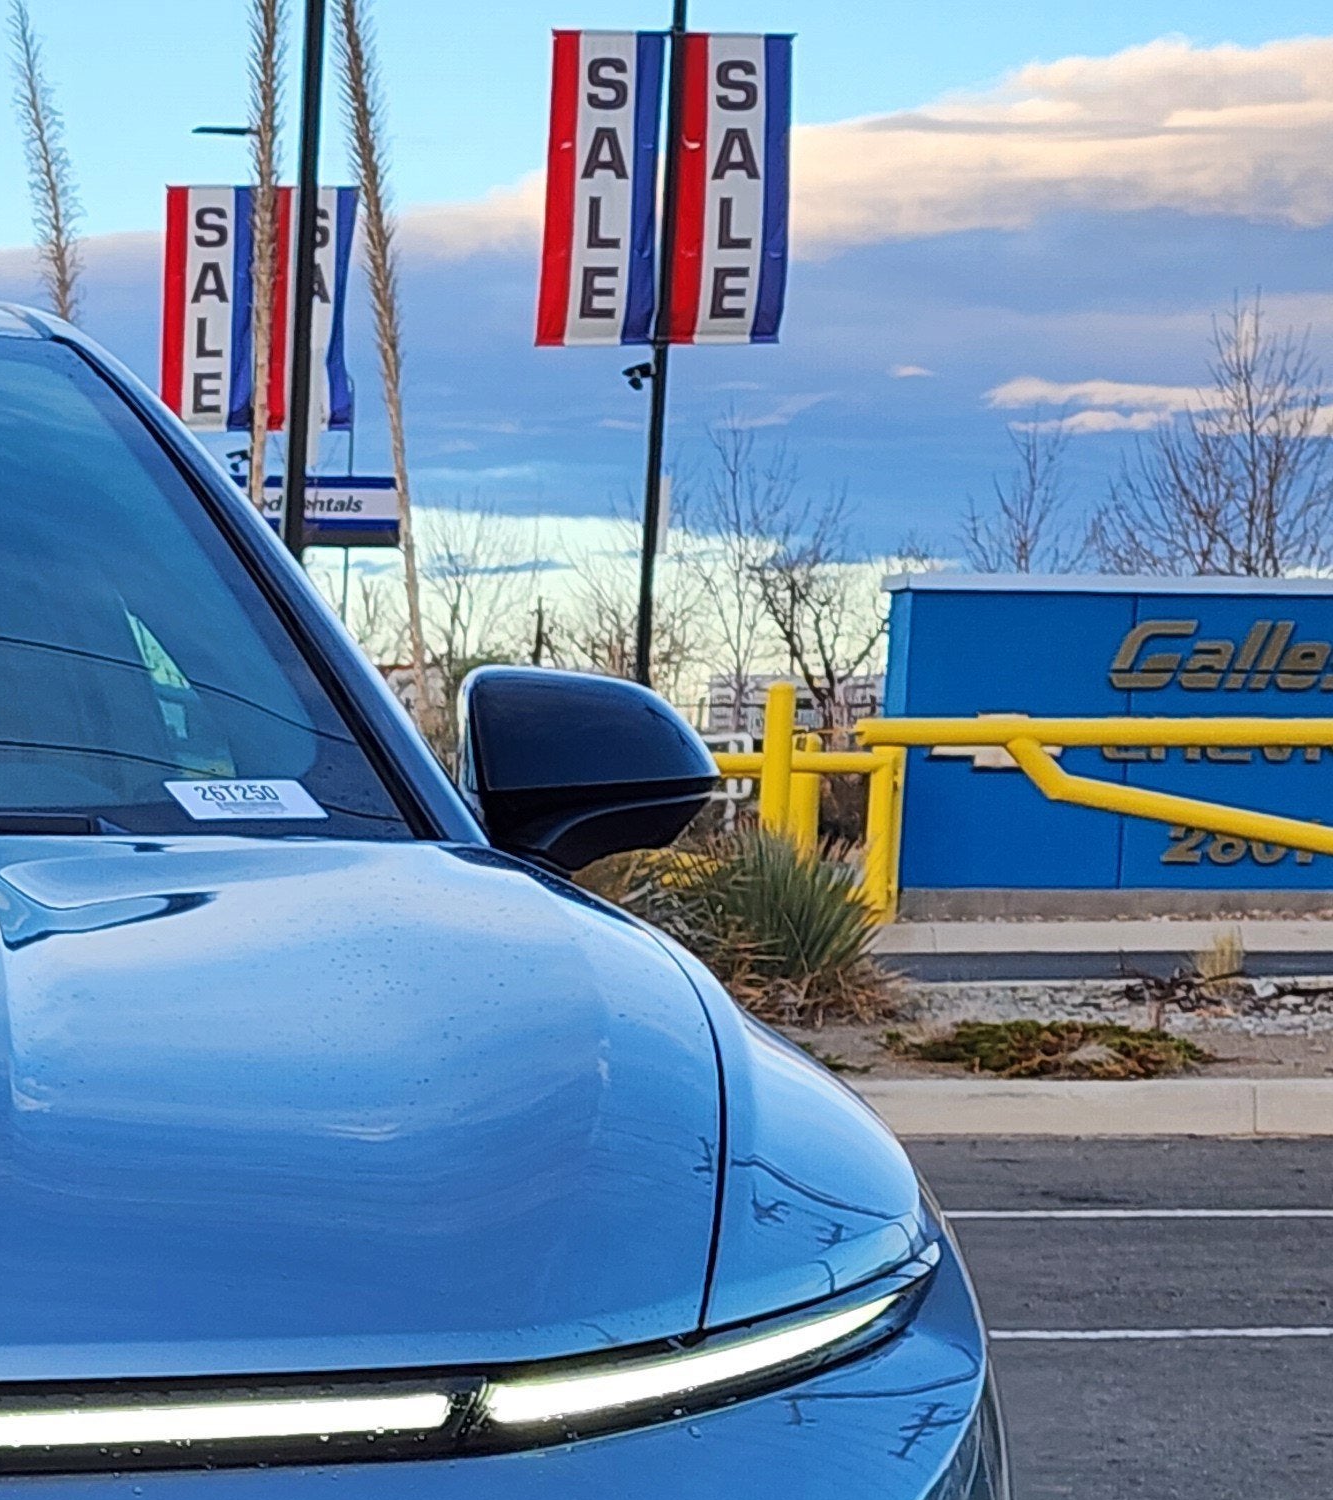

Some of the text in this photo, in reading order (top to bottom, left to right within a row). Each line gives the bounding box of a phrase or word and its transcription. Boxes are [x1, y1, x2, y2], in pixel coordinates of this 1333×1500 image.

[579, 57, 629, 319] SALE
[709, 60, 761, 320] SALE
[191, 207, 229, 414] SALE
[1109, 619, 1333, 690] Galle
[194, 785, 280, 802] 26T250
